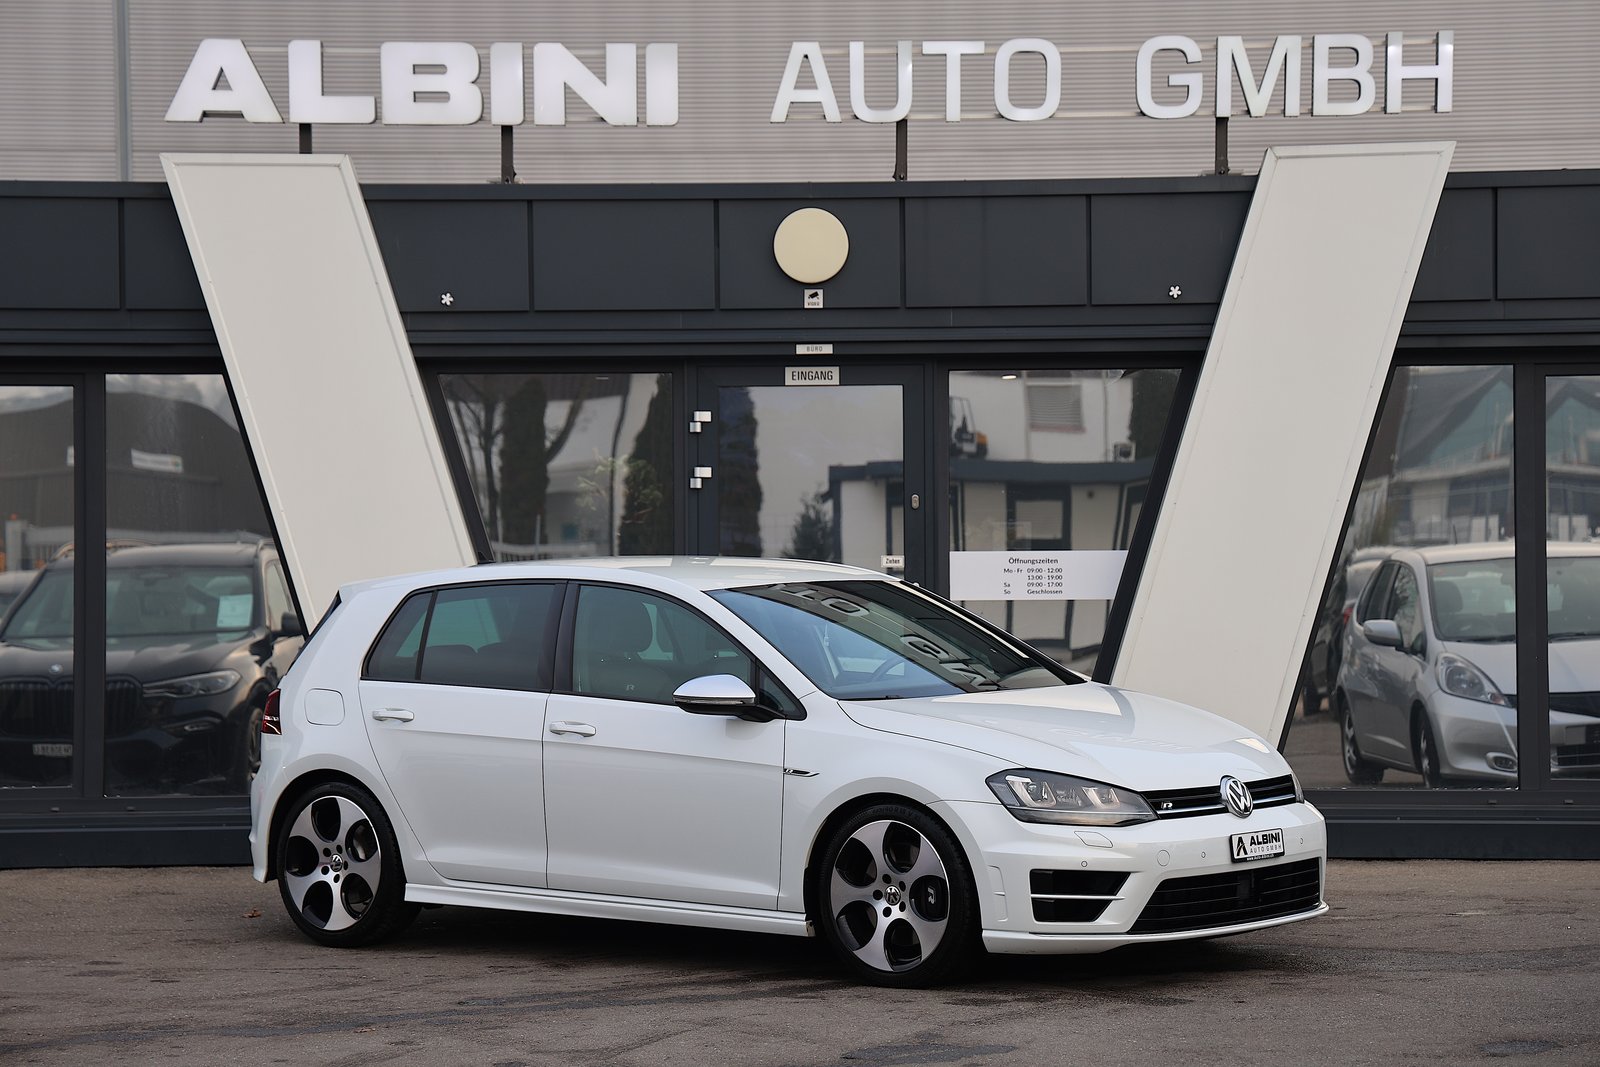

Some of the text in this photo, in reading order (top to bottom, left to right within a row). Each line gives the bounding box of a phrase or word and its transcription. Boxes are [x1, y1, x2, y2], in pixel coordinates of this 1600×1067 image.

[164, 30, 1455, 127] ALBINI AUTO GMBH
[791, 371, 833, 381] EINGANG
[1008, 557, 1059, 565] Öffnungszeiten
[1250, 831, 1281, 847] ALBINI
[1250, 844, 1282, 854] AUTO GMBH
